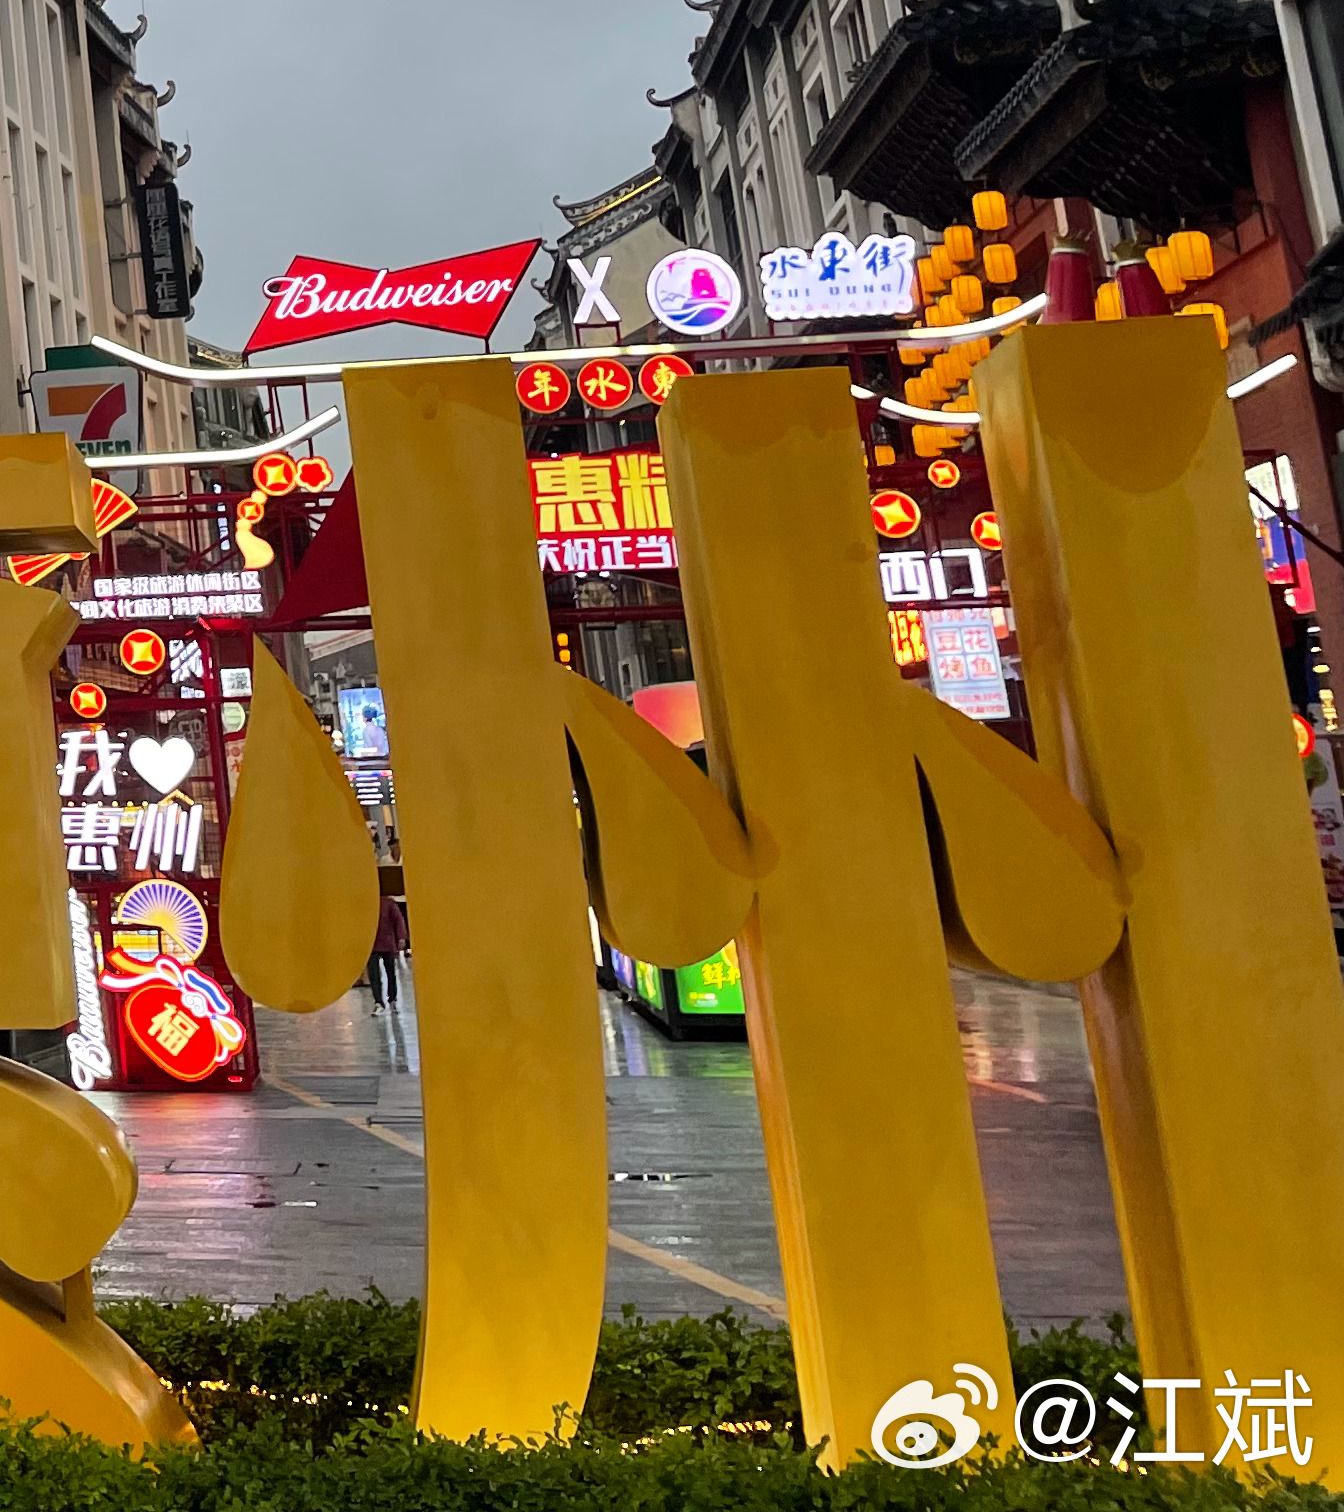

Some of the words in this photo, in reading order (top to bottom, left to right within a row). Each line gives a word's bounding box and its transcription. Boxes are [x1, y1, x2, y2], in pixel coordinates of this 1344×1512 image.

[262, 268, 512, 319] Budweiser
[769, 240, 906, 294] 水東街
[537, 535, 679, 572] 庆祝正当
[56, 730, 126, 796] 我
[60, 803, 204, 872] 惠州
[147, 1002, 200, 1057] 福
